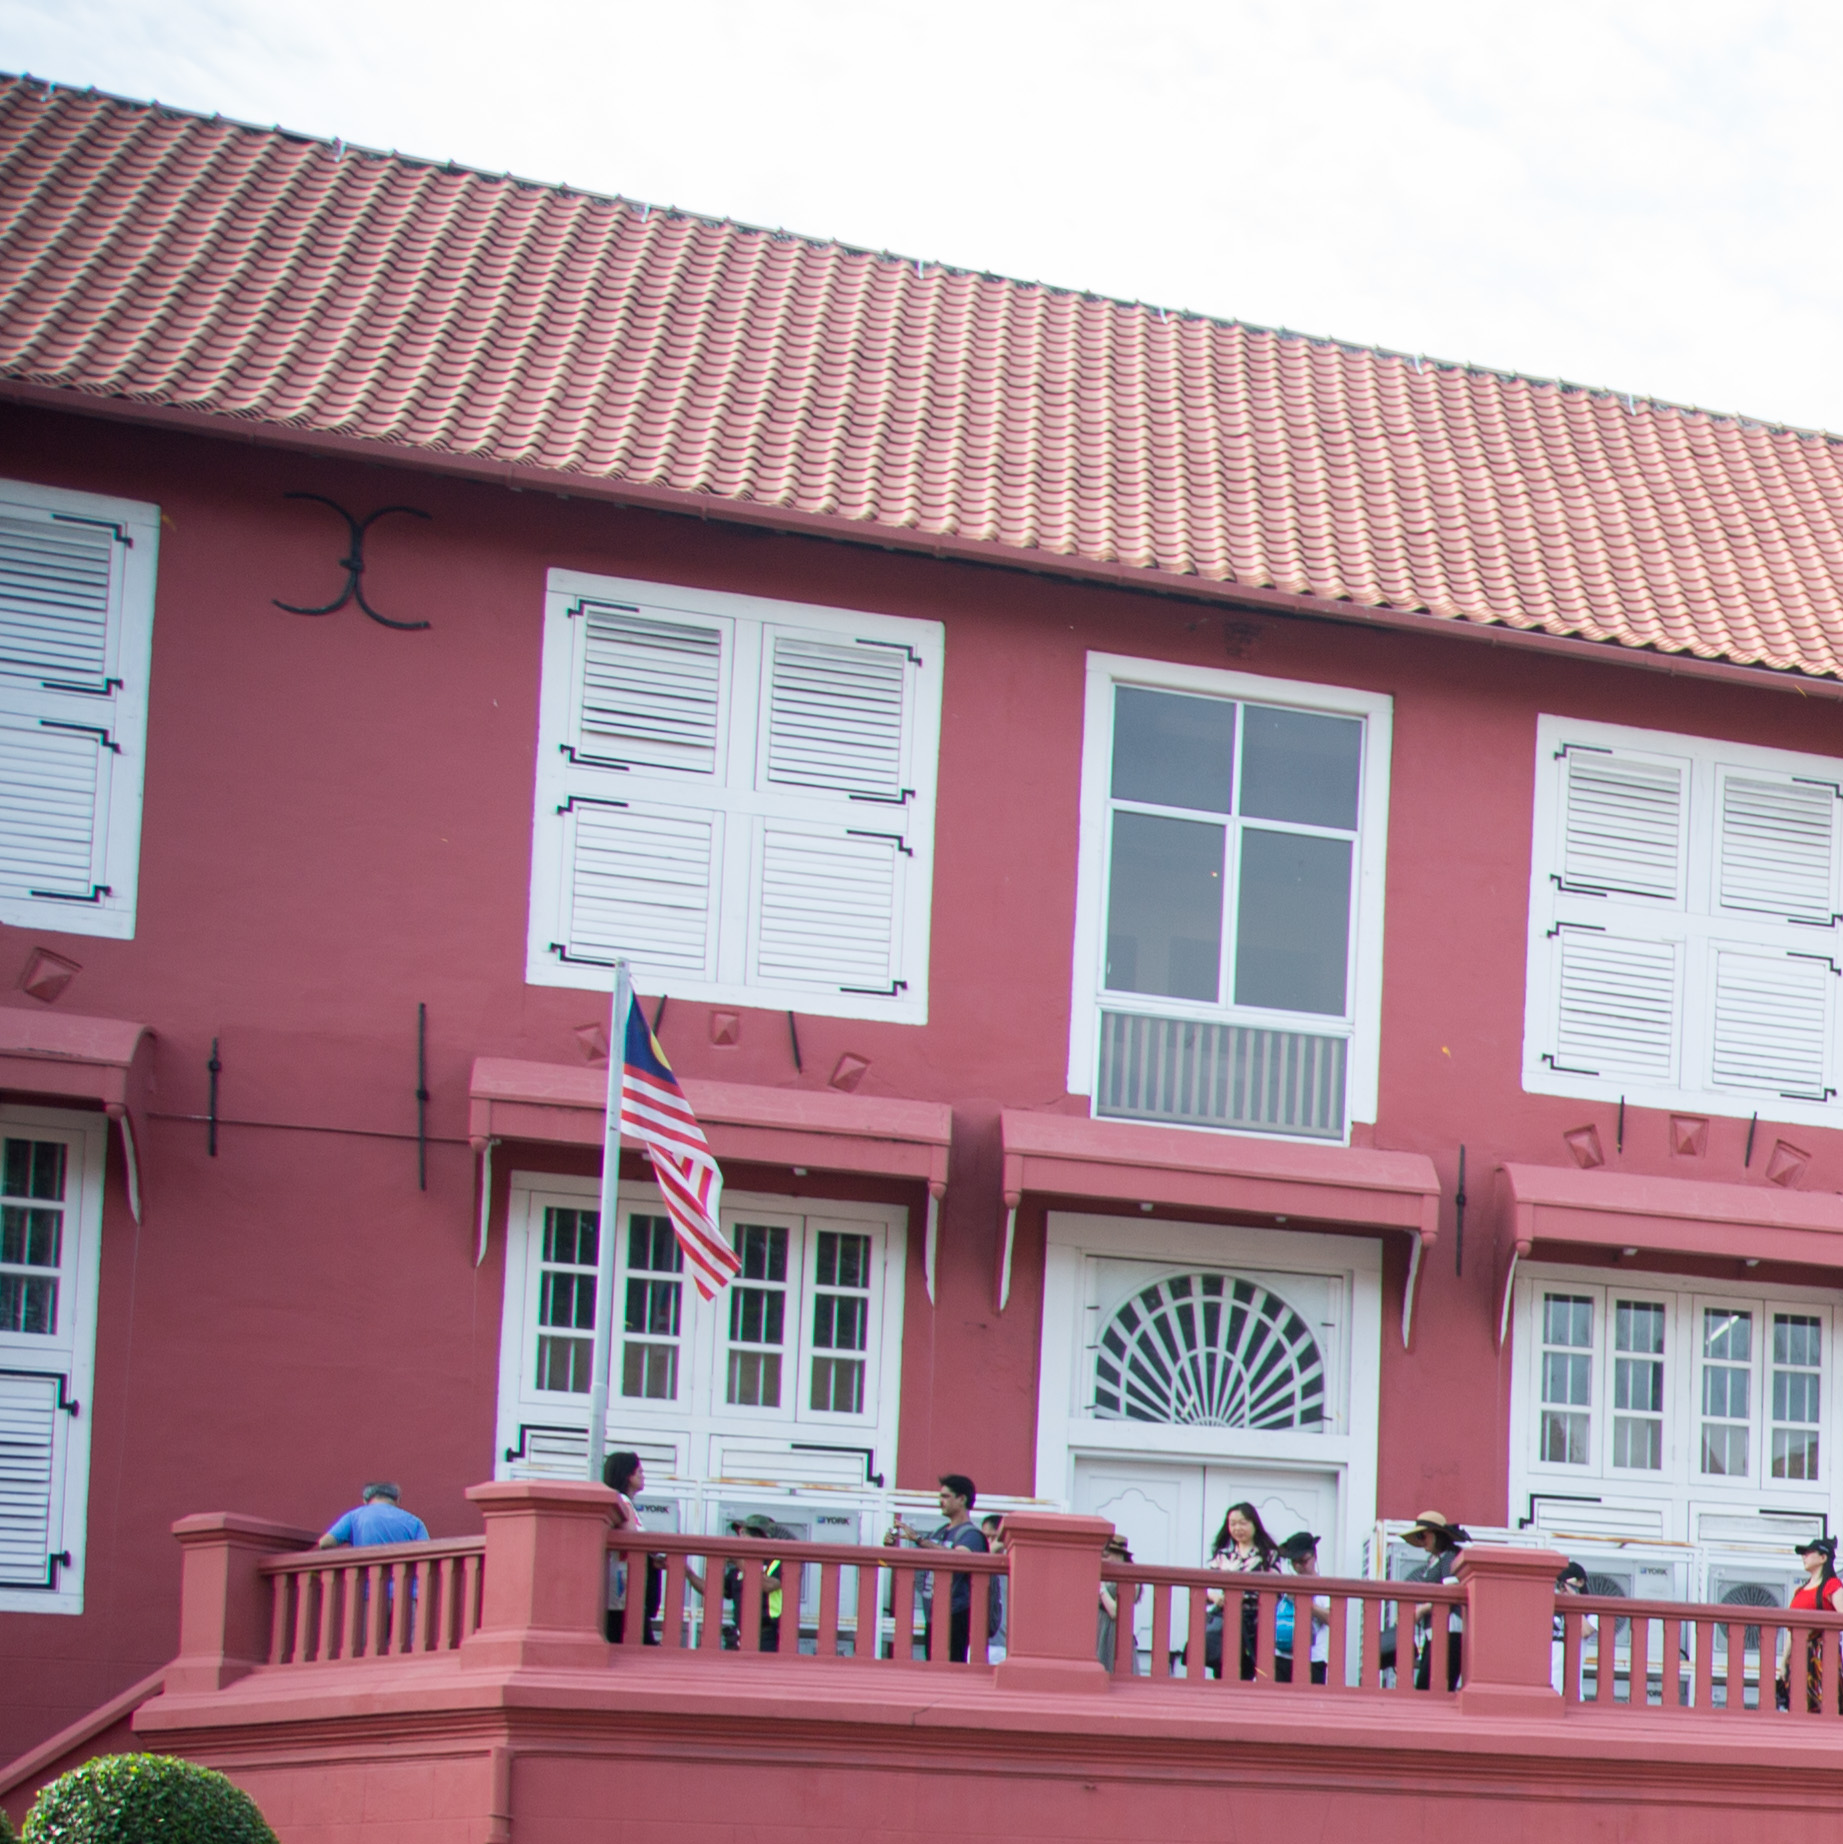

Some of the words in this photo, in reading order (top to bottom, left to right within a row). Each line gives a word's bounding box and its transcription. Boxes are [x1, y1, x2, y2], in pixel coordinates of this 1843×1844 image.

[643, 1504, 670, 1514] YORK
[824, 1516, 850, 1526] YORK
[1646, 1567, 1668, 1577] YORK
